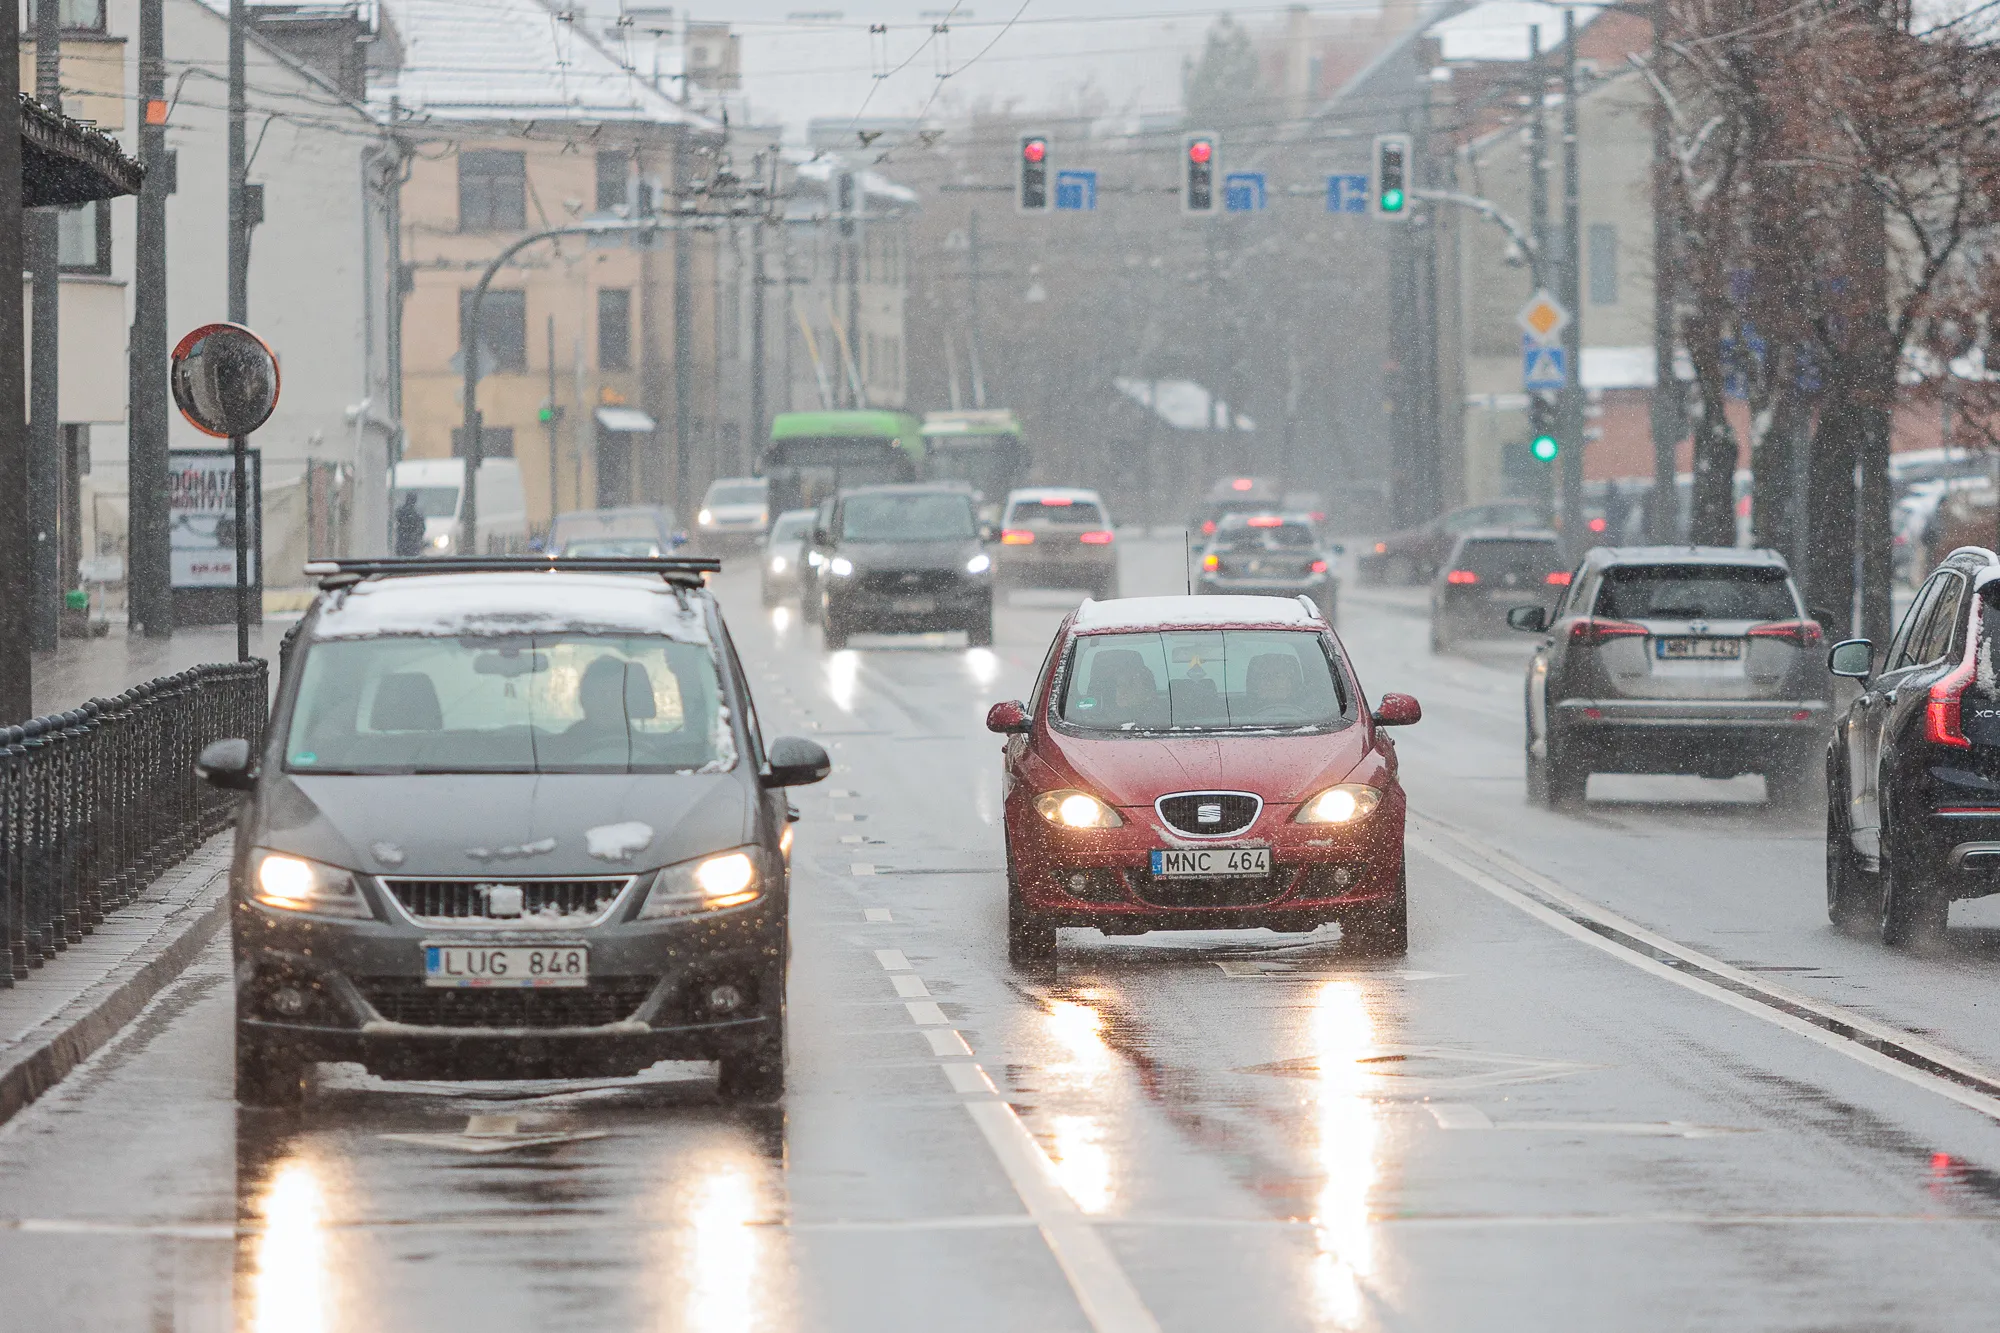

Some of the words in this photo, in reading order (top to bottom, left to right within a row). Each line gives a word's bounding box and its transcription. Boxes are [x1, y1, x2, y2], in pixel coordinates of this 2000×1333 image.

[1165, 852, 1211, 872] MNC
[1228, 851, 1265, 871] 464
[445, 951, 508, 975] LUG
[529, 951, 580, 975] 848
